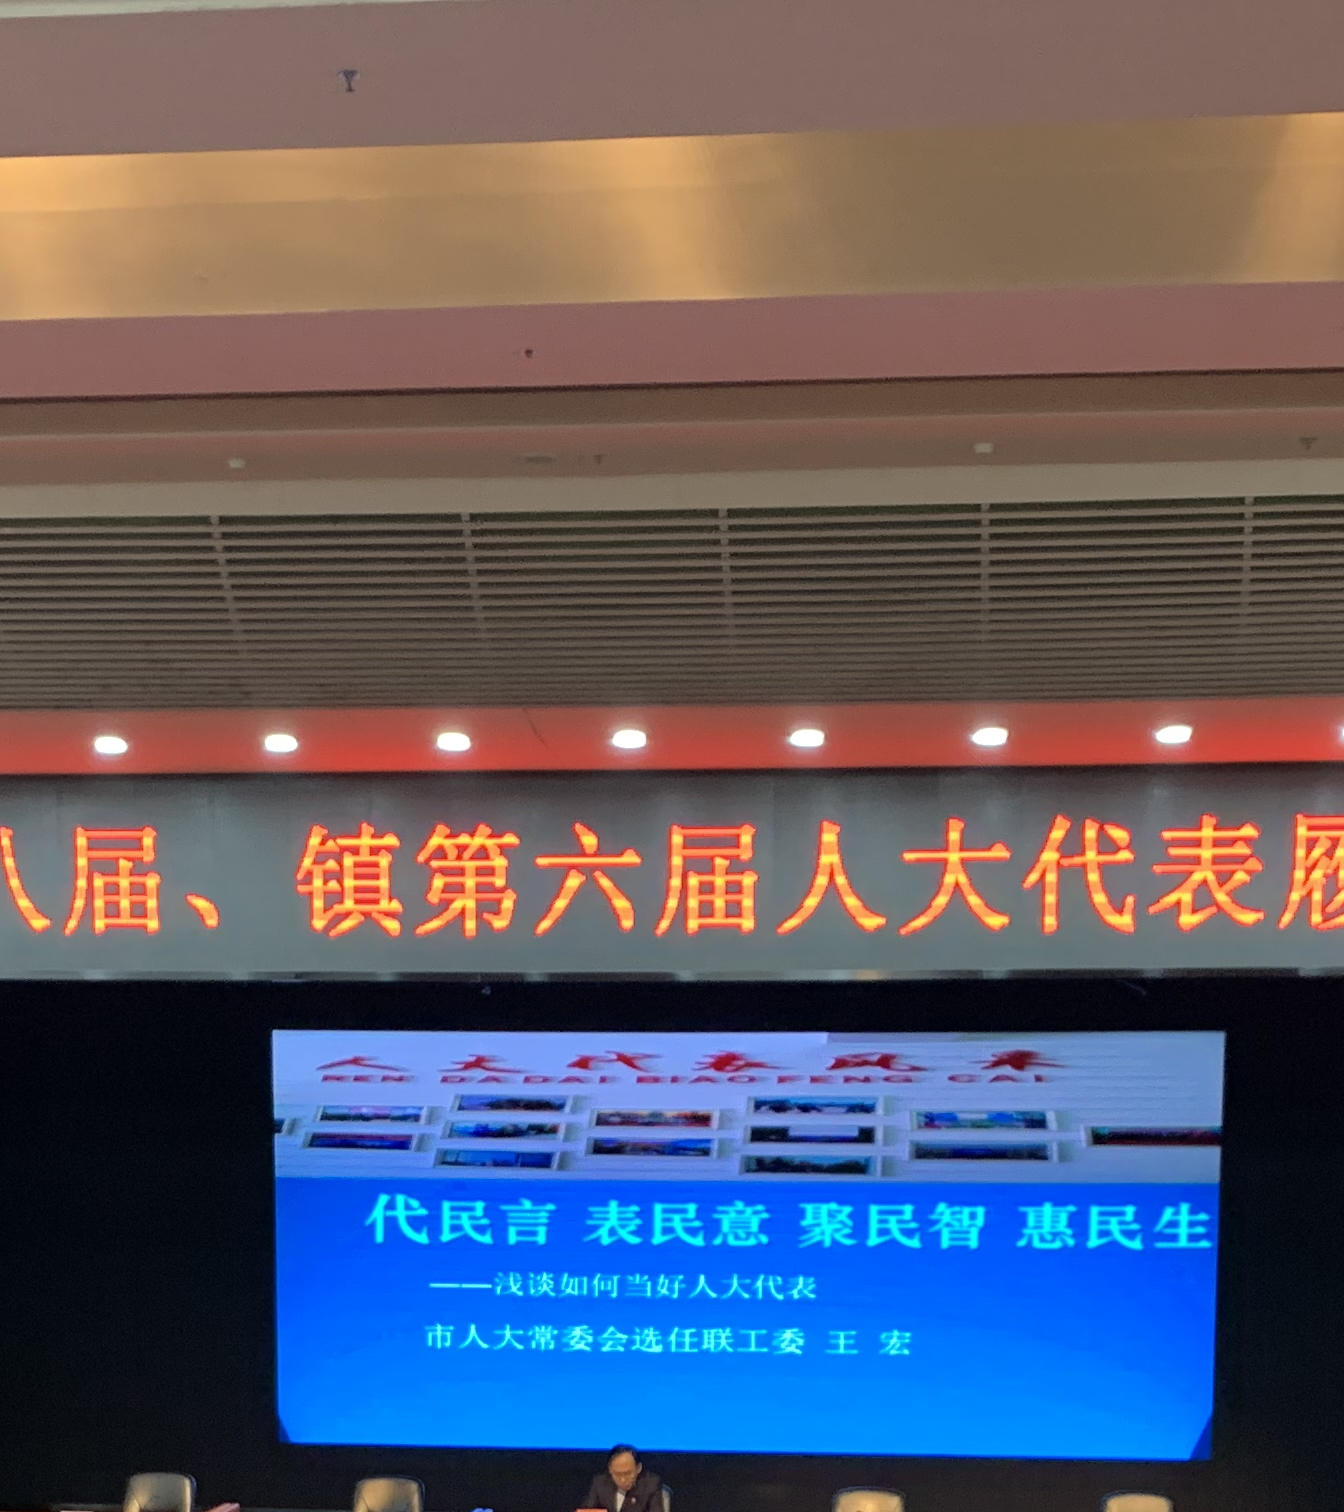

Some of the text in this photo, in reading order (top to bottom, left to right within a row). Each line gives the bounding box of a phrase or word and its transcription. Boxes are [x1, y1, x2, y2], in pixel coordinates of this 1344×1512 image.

[366, 1193, 1211, 1250] 代民言 表民意 聚民智 惠民生
[425, 1323, 912, 1356] 市人大常委会选任联工委 王 宏
